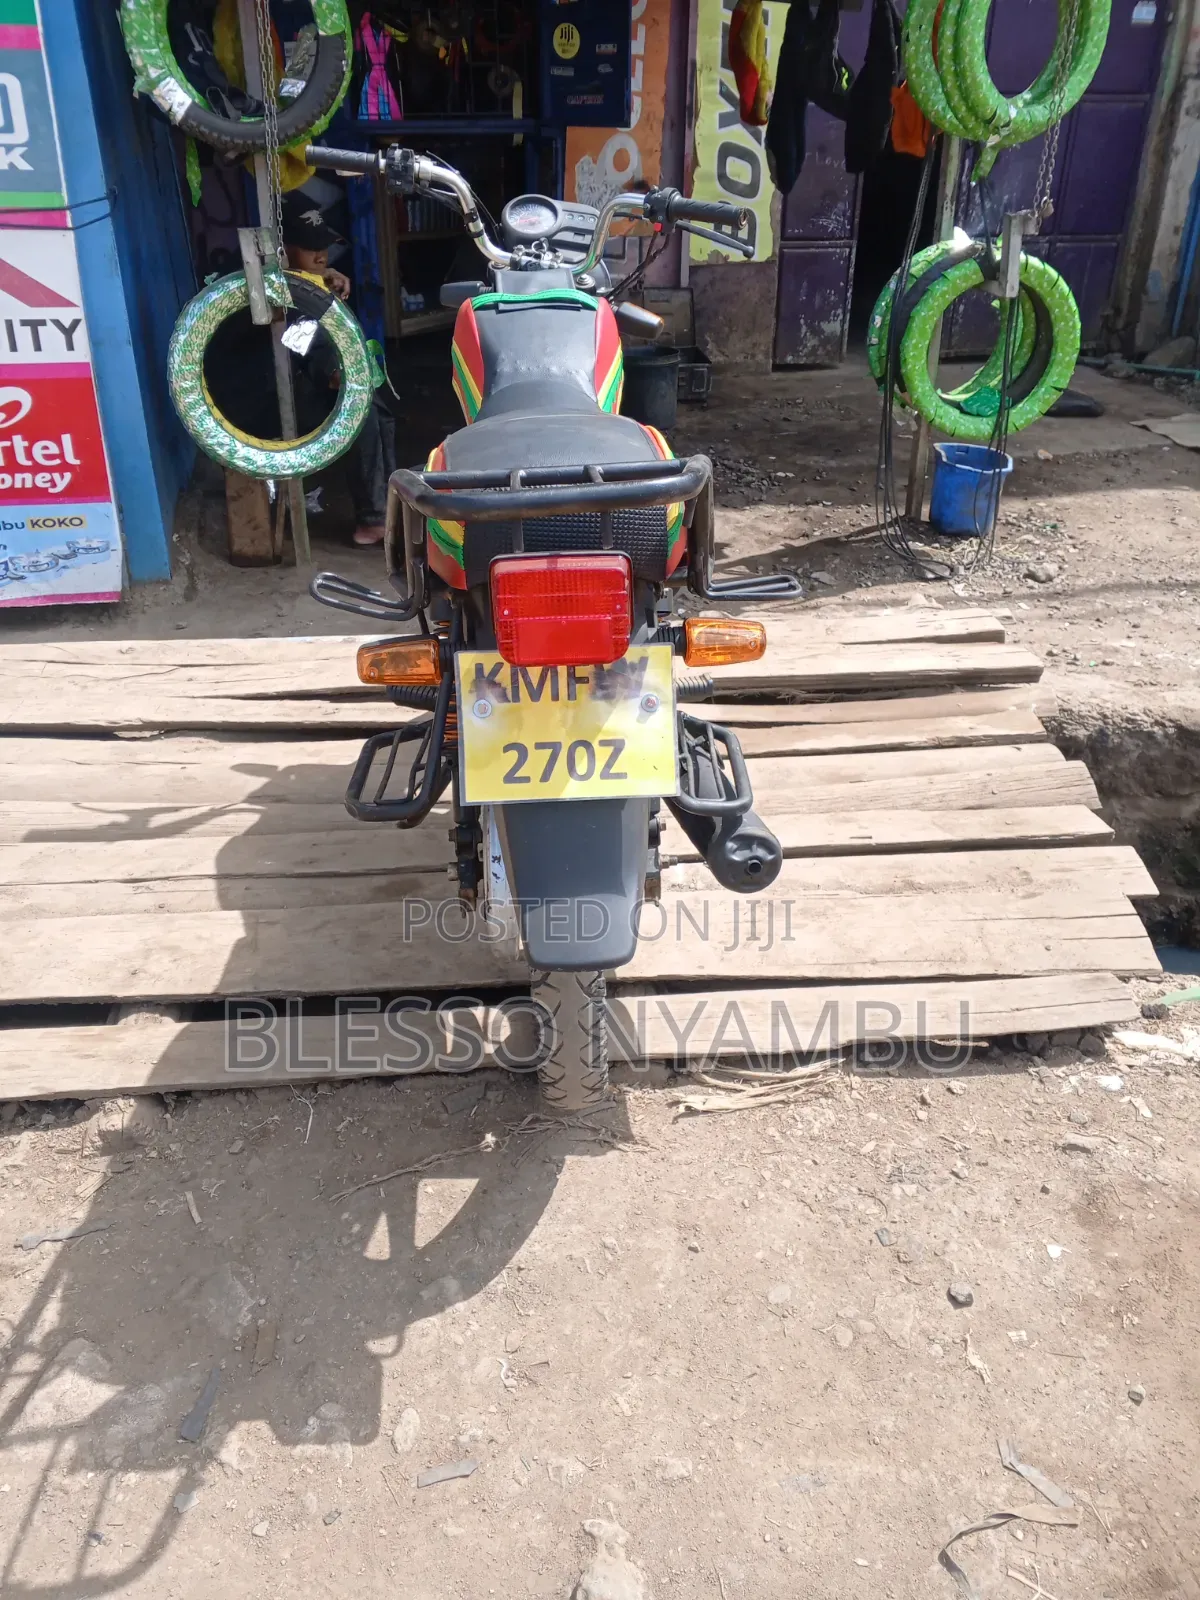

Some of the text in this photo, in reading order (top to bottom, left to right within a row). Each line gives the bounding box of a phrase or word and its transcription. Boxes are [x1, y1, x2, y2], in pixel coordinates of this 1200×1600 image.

[714, 0, 771, 258] BOX
[3, 319, 83, 353] ITY
[30, 517, 84, 529] KOKO
[502, 738, 628, 785] 270Z
